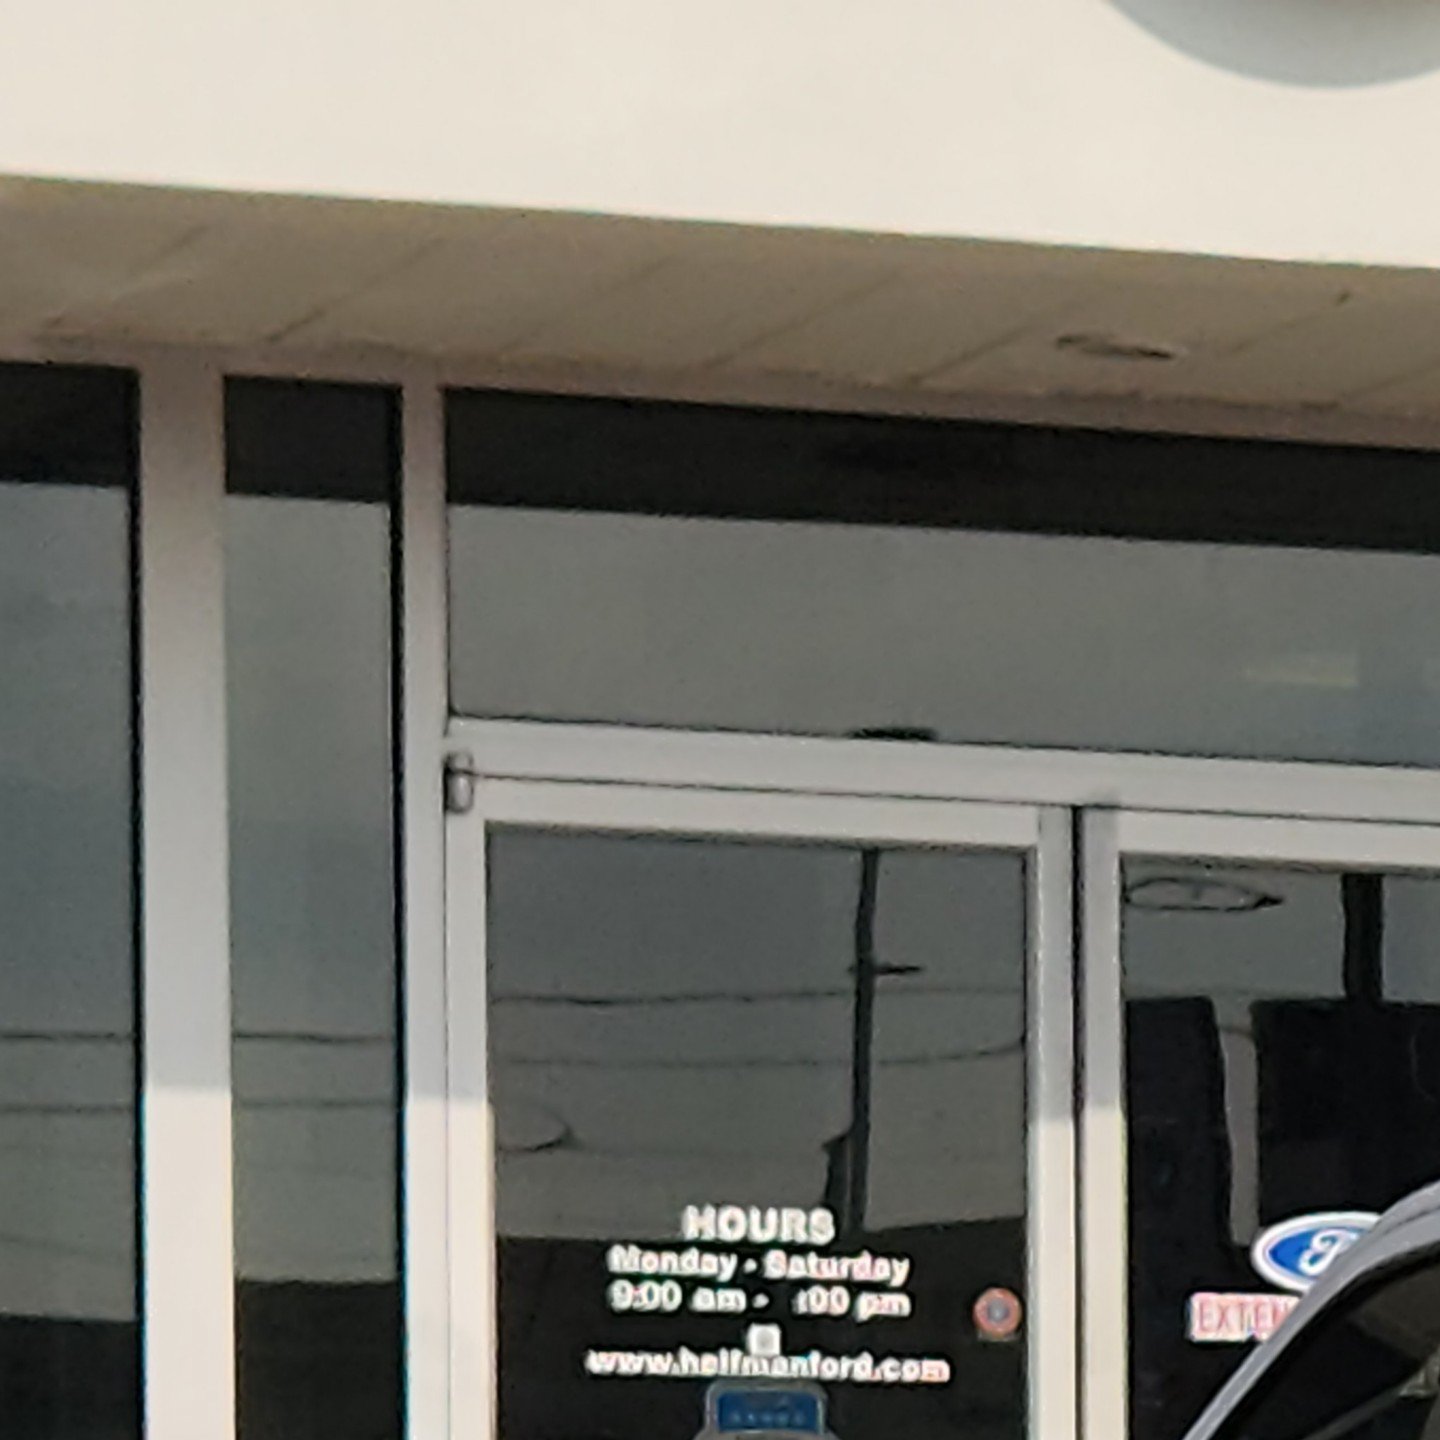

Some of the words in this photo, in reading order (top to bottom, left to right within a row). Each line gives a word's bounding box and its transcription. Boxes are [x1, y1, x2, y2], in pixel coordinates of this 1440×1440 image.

[682, 1205, 835, 1245] HOURS
[607, 1245, 737, 1282] Monday
[764, 1250, 909, 1287] Saturday
[608, 1279, 682, 1311] 9:00
[689, 1287, 747, 1312] am
[855, 1292, 911, 1322] pm
[585, 1346, 950, 1383] www.helfmanford.com
